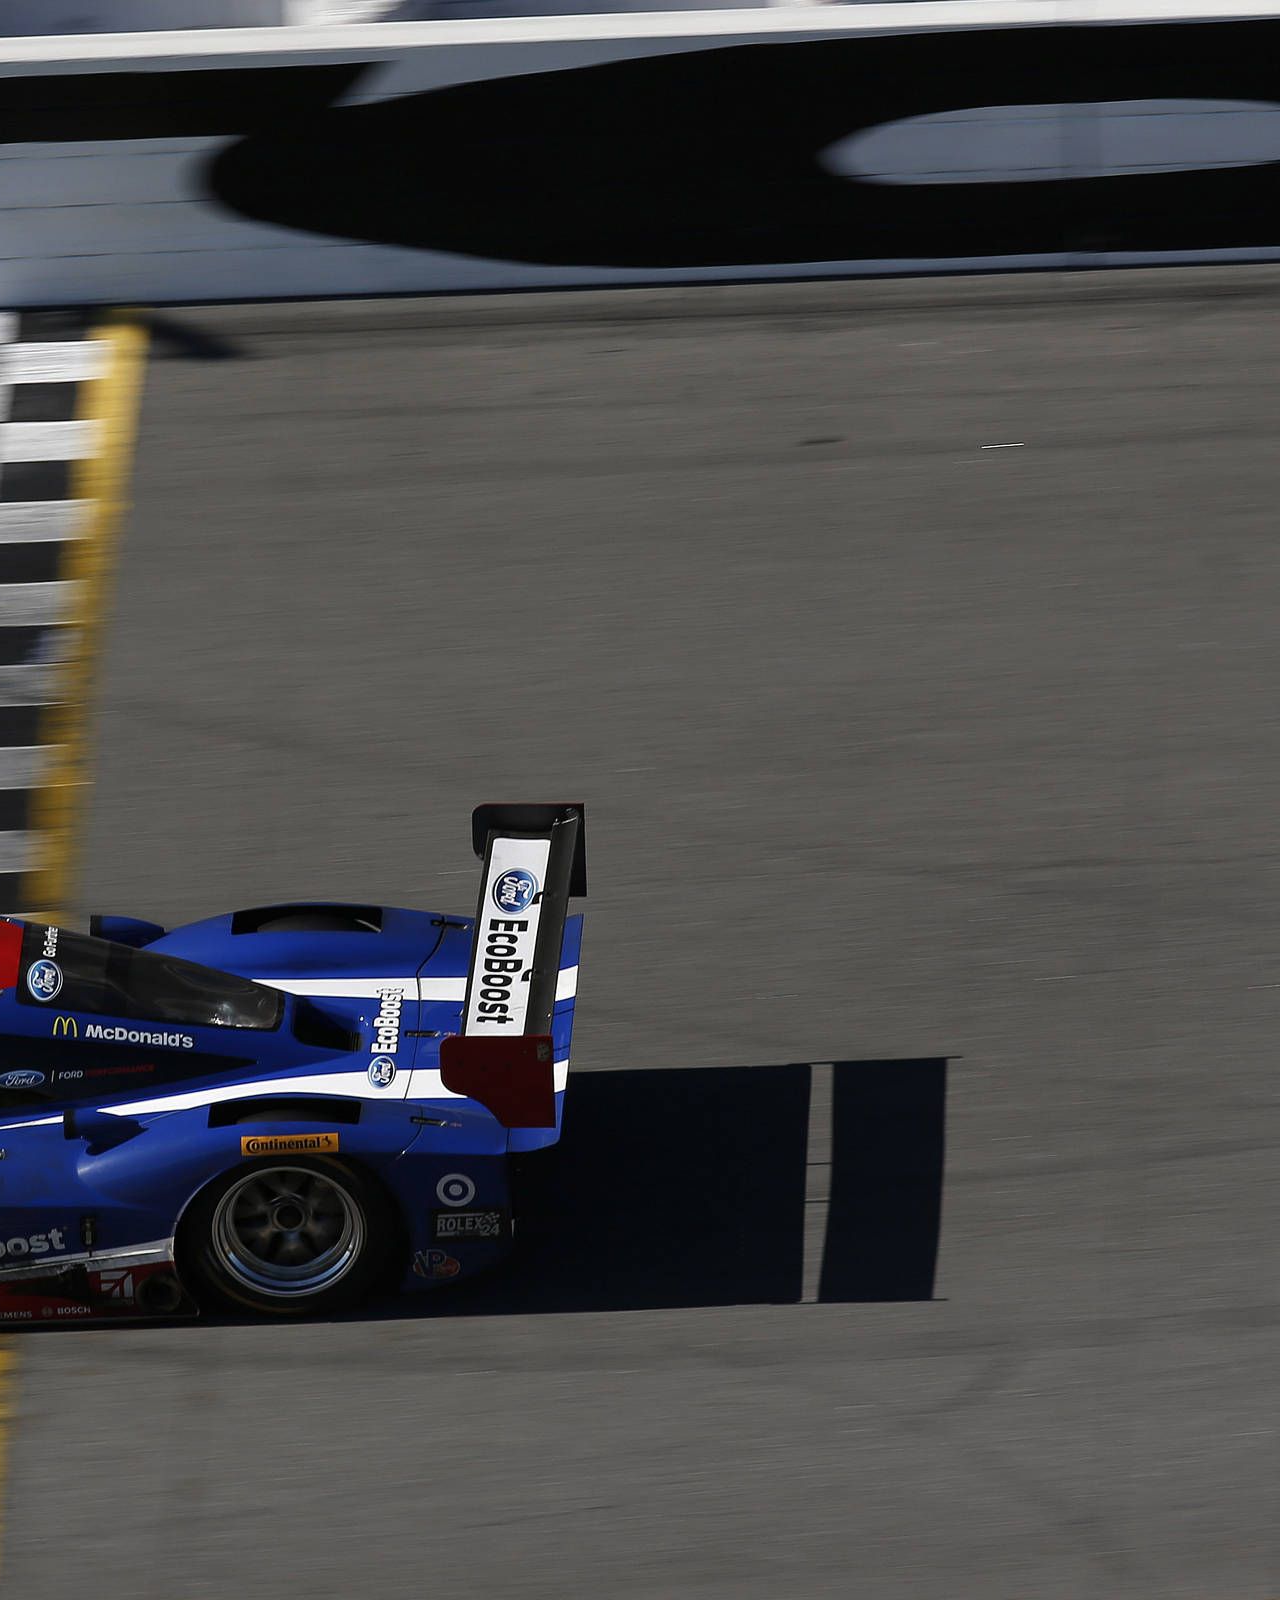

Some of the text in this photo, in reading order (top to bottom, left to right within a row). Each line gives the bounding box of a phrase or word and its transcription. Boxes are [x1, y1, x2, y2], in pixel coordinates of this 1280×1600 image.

[499, 876, 532, 906] Ford
[476, 918, 529, 1024] EcoBoost
[371, 988, 404, 1054] EcoBoost
[85, 1024, 194, 1049] McDonald's
[58, 1063, 156, 1080] FORD RMANCE
[246, 1137, 321, 1153] Continental
[437, 1217, 501, 1237] ROLEX 24
[57, 1306, 91, 1315] BOSCH
